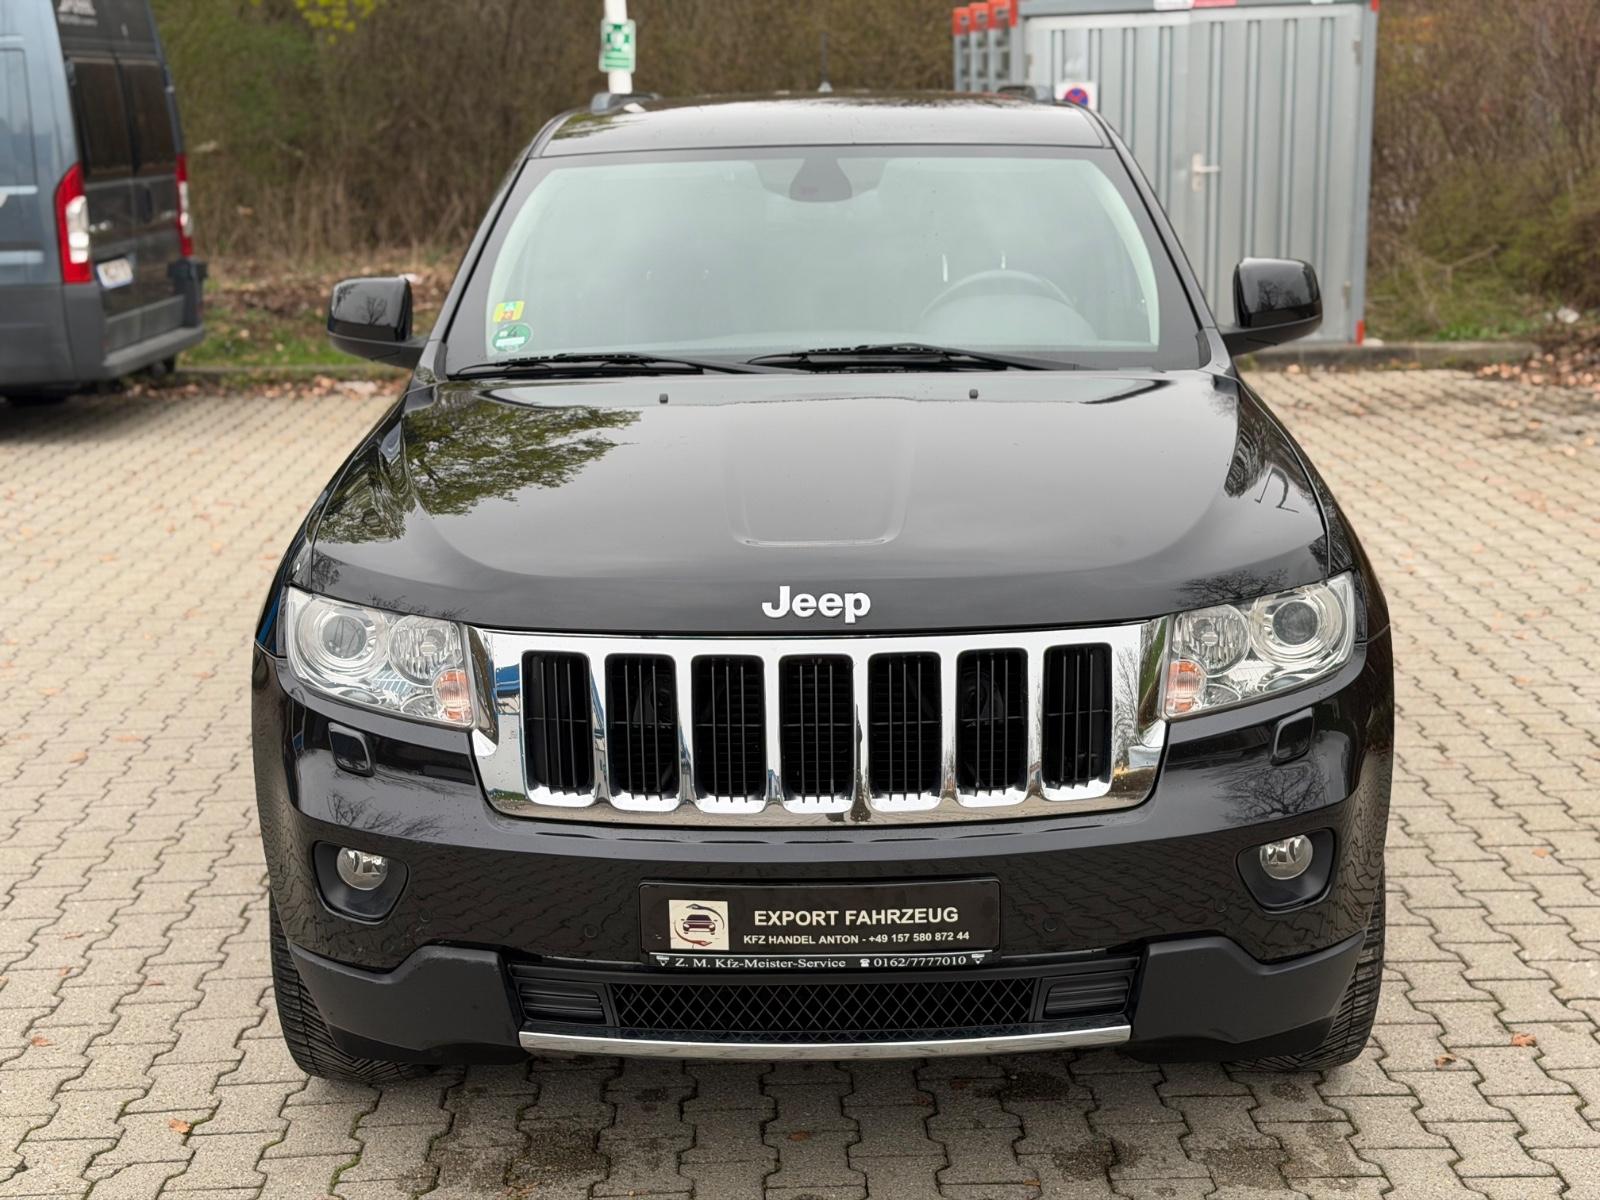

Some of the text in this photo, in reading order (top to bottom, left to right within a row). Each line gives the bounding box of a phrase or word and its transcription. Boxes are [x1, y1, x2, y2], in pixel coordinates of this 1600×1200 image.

[761, 585, 871, 624] Jeep
[754, 906, 959, 926] EXPORT FAHRZEUG
[743, 935, 766, 944] KFZ
[768, 935, 816, 944] HANDEL
[818, 935, 859, 944] ANTON
[868, 934, 888, 943] +49
[891, 933, 910, 943] 157
[913, 932, 932, 942] 580
[935, 931, 954, 941] 872
[956, 931, 970, 940] 44
[675, 956, 967, 969] Z. M. Kfz-Meister-Service 0162/7777010
